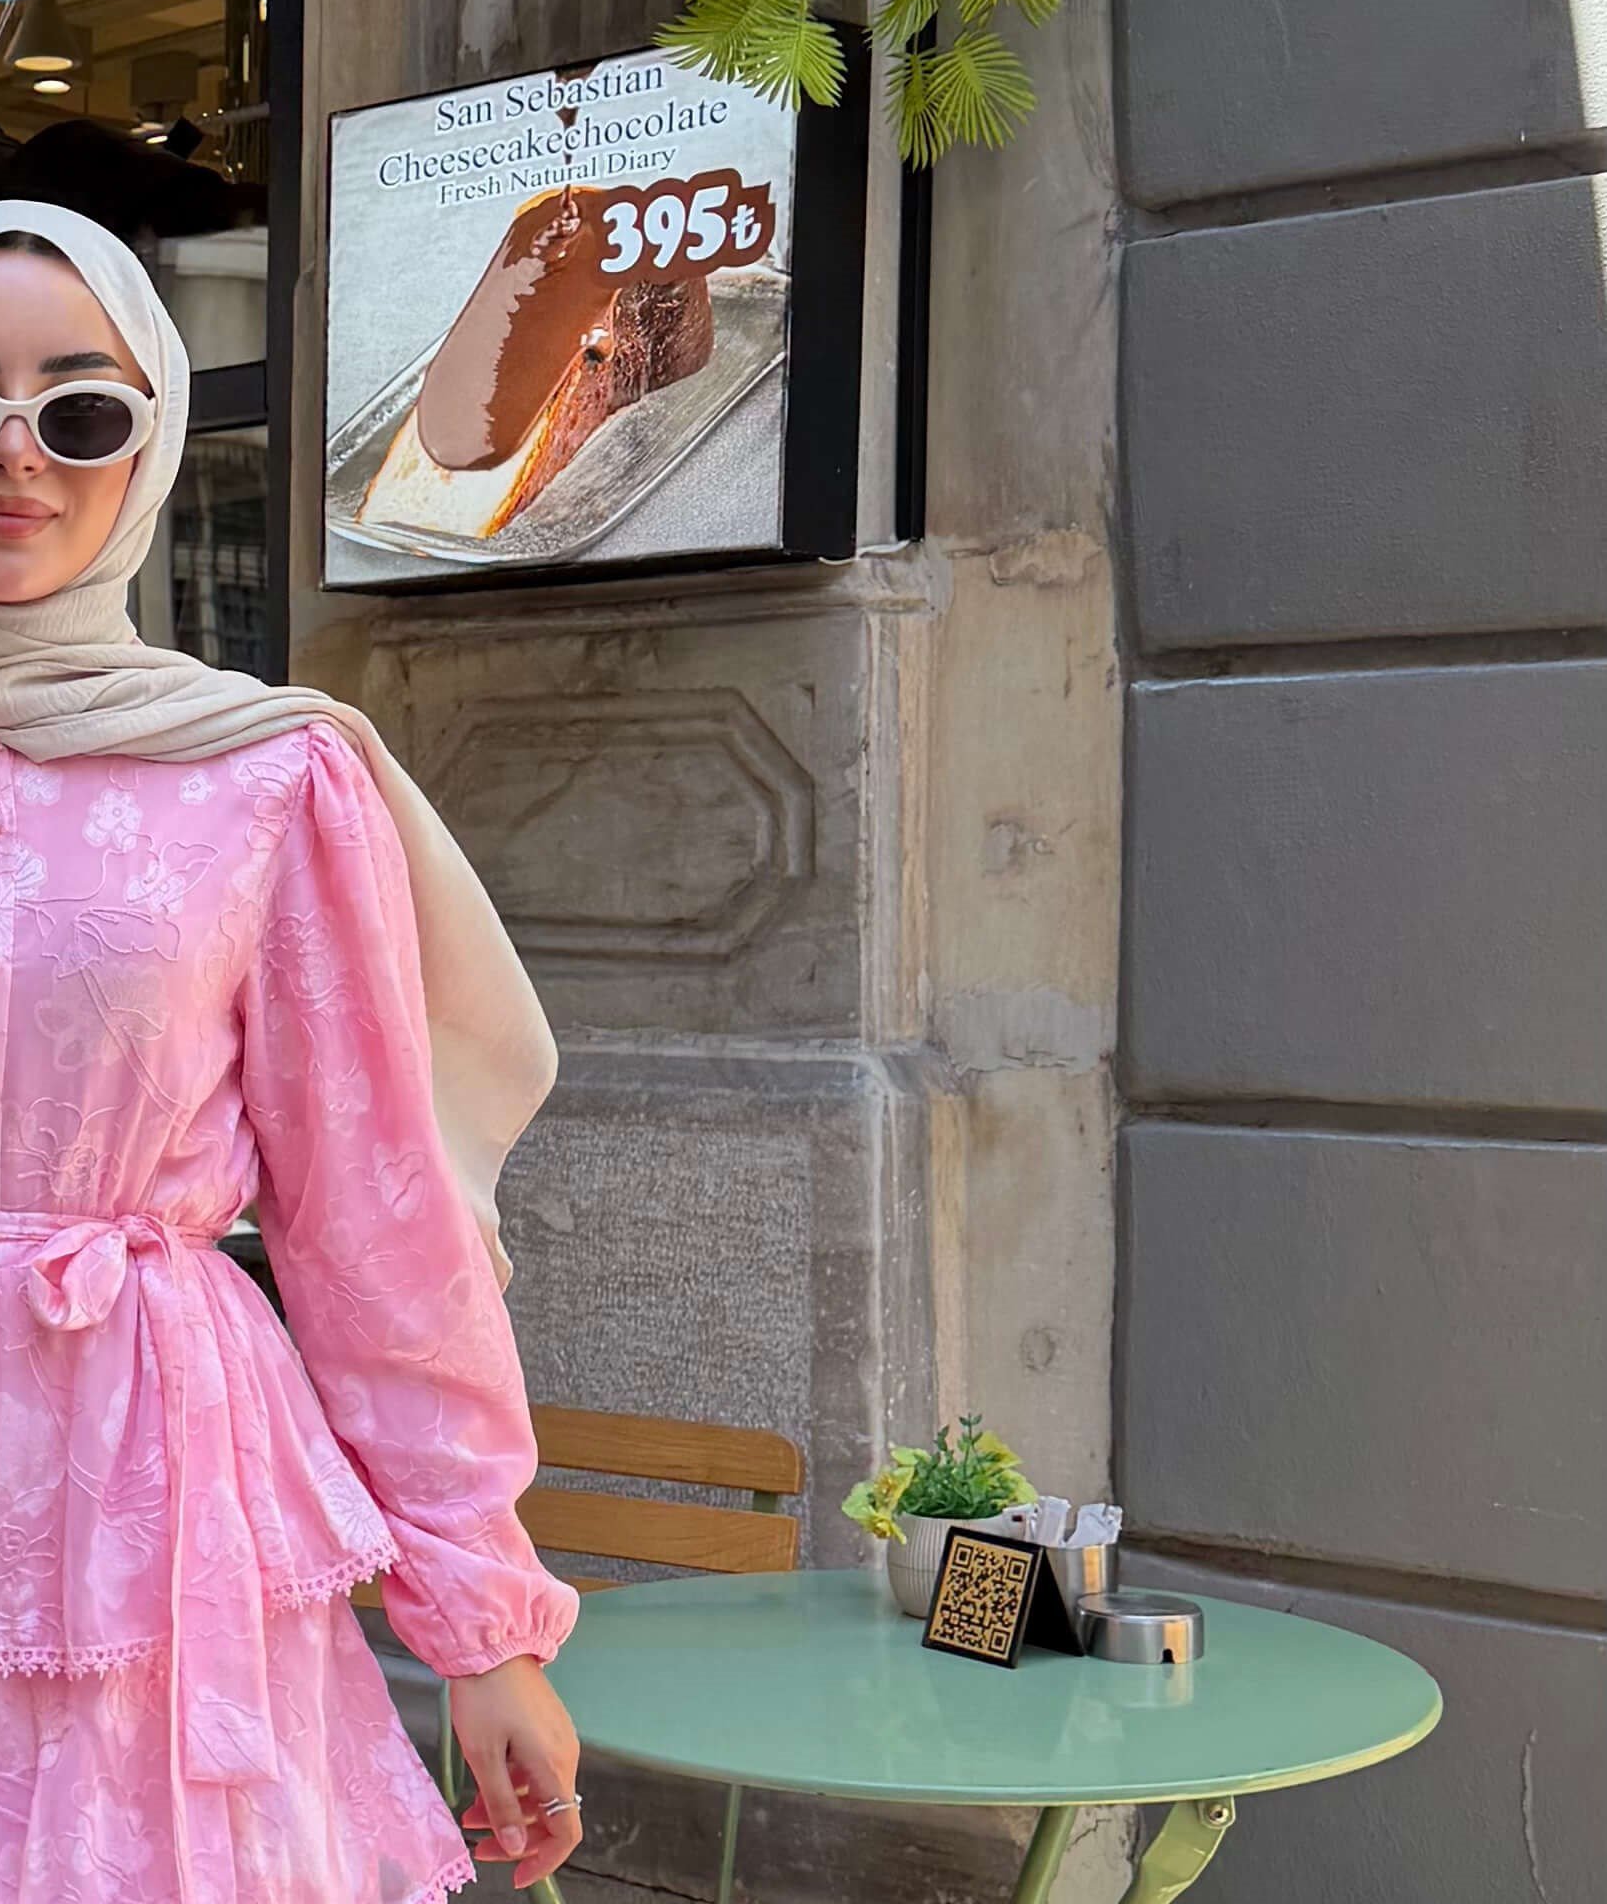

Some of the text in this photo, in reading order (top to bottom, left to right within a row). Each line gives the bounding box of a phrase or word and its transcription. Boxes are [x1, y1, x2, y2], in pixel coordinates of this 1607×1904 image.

[436, 63, 663, 132] San Sebastian
[379, 100, 729, 188] Cheesecakechocolate
[439, 147, 677, 206] Fresh Natural Diary
